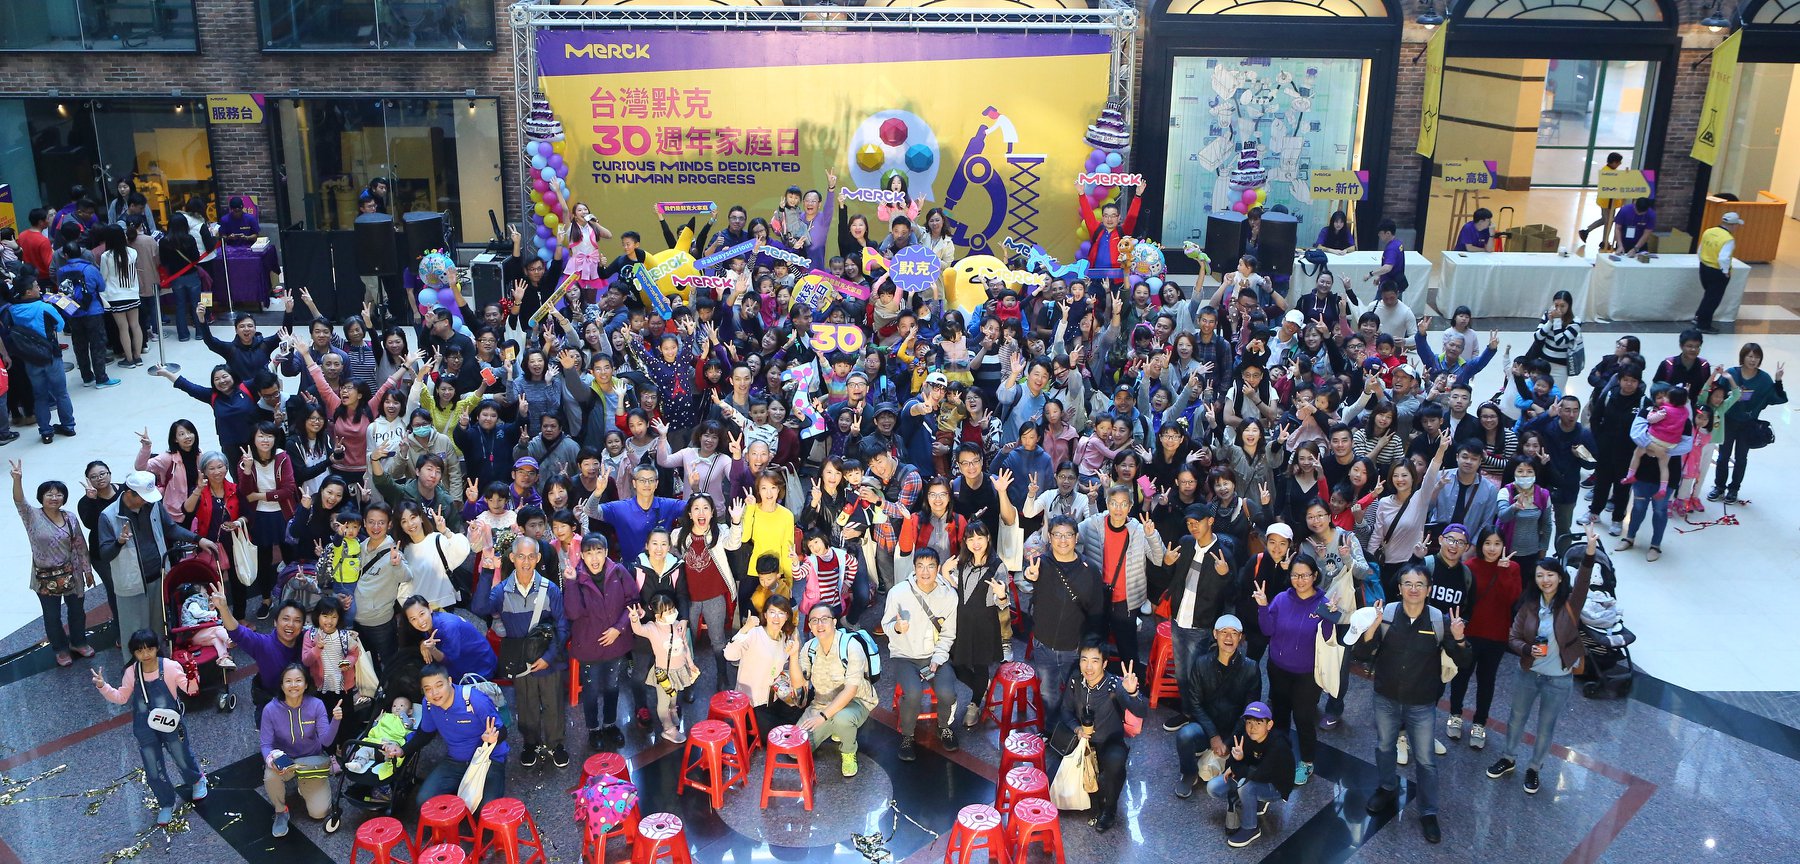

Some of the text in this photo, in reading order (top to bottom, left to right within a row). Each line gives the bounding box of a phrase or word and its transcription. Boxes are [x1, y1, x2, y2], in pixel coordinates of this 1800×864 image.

[565, 43, 650, 59] MERCK
[590, 86, 713, 119] 台灣默克
[212, 106, 253, 120] 服務台
[593, 161, 800, 172] CURIOUS MINDS DEDICATED
[592, 174, 755, 184] TO HUMAN PROGRESS
[1080, 174, 1140, 185] MERCK
[1466, 172, 1488, 184] 高雄
[843, 188, 905, 202] MERCK
[1336, 182, 1359, 194] 新竹
[701, 241, 754, 265] #alwayscurious
[899, 260, 930, 275] 默克
[672, 275, 733, 288] MERCK
[810, 324, 863, 352] 30
[1432, 585, 1462, 604] 1960
[153, 715, 175, 727] FILA
